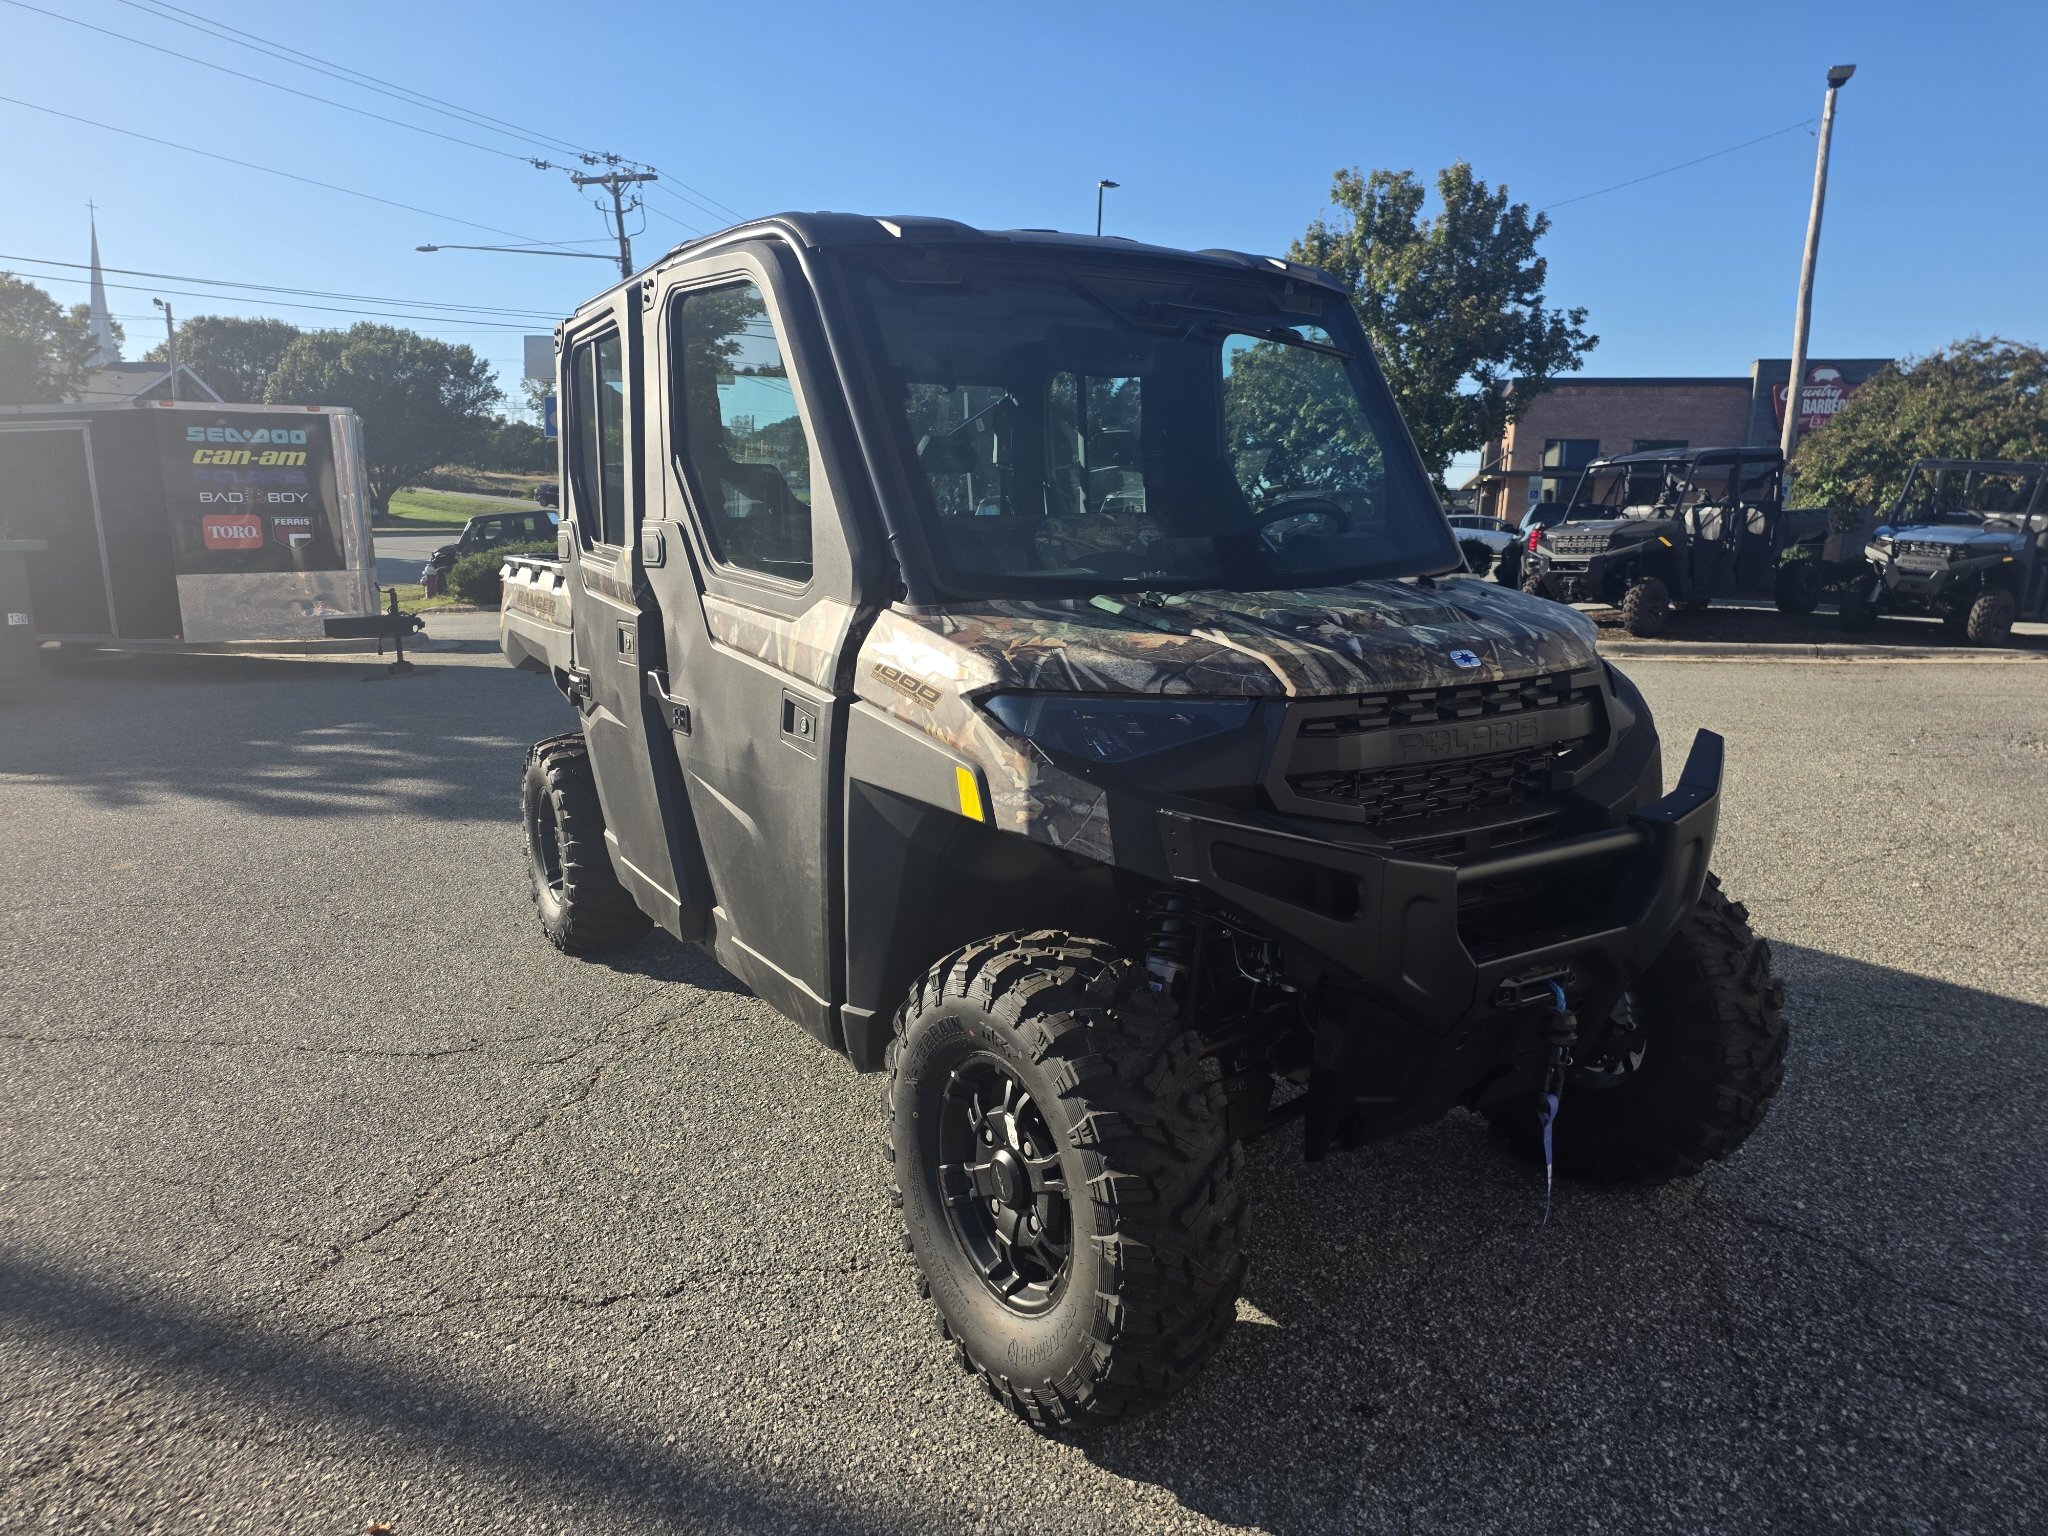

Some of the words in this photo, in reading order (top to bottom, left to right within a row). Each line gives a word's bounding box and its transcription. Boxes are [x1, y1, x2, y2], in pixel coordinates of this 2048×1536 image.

[199, 492, 244, 503] BAD
[267, 492, 309, 503] BOY
[274, 518, 310, 526] FERRIS
[207, 526, 258, 539] TORO
[517, 590, 557, 616] RANGER
[873, 661, 944, 705] 1000
[1399, 717, 1538, 760] POLARIS
